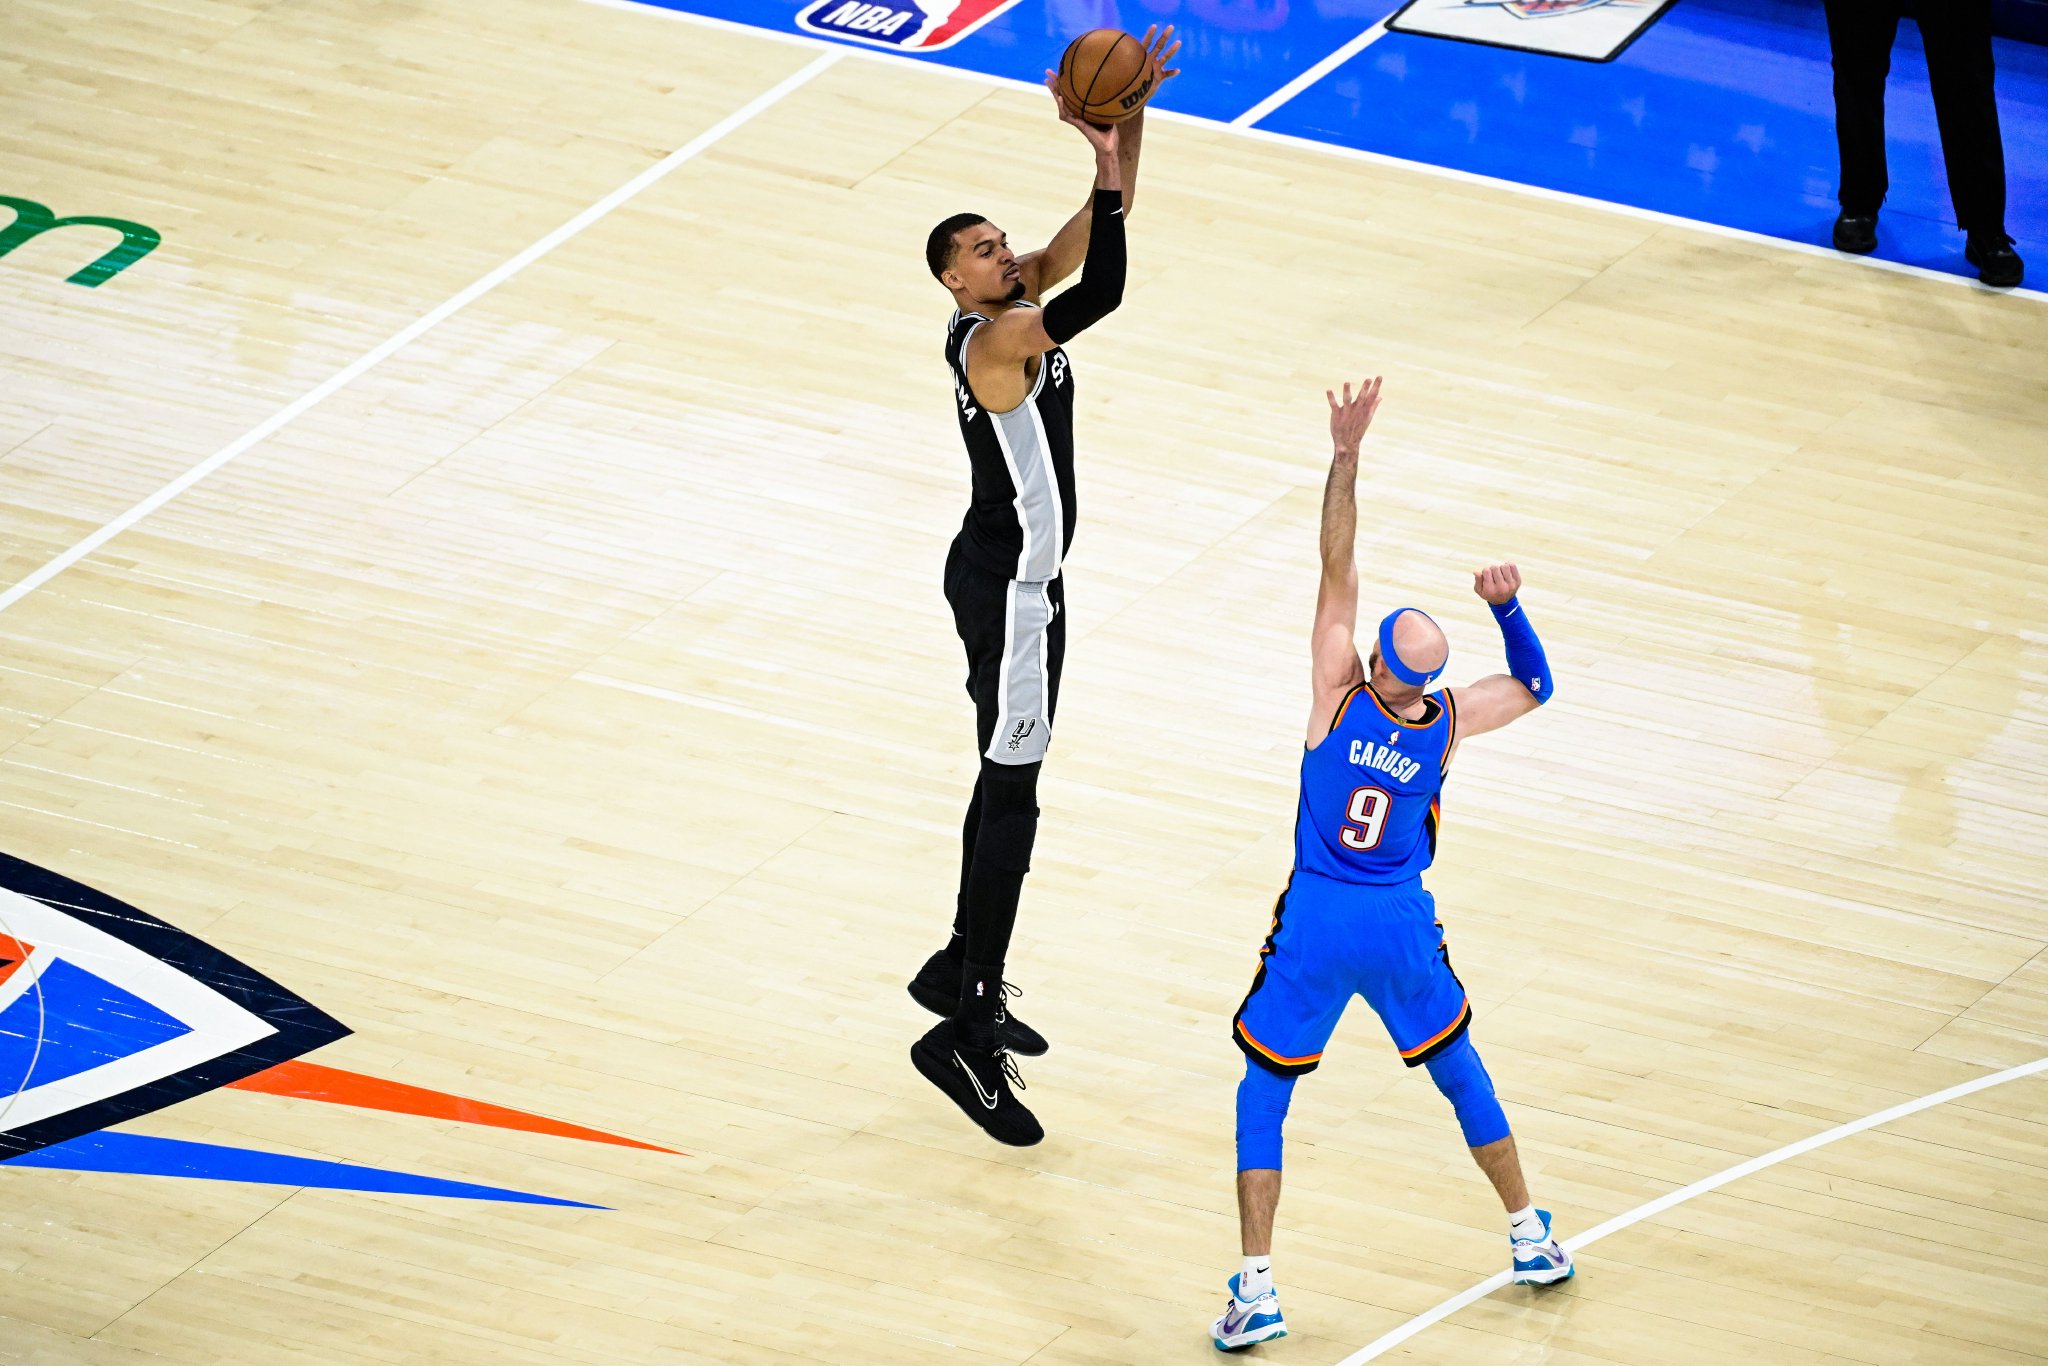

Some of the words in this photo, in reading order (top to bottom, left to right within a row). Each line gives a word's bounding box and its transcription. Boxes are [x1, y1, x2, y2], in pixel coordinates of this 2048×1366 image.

[821, 0, 914, 36] NBA
[1348, 739, 1422, 784] CARUSO
[1338, 785, 1393, 852] 9
